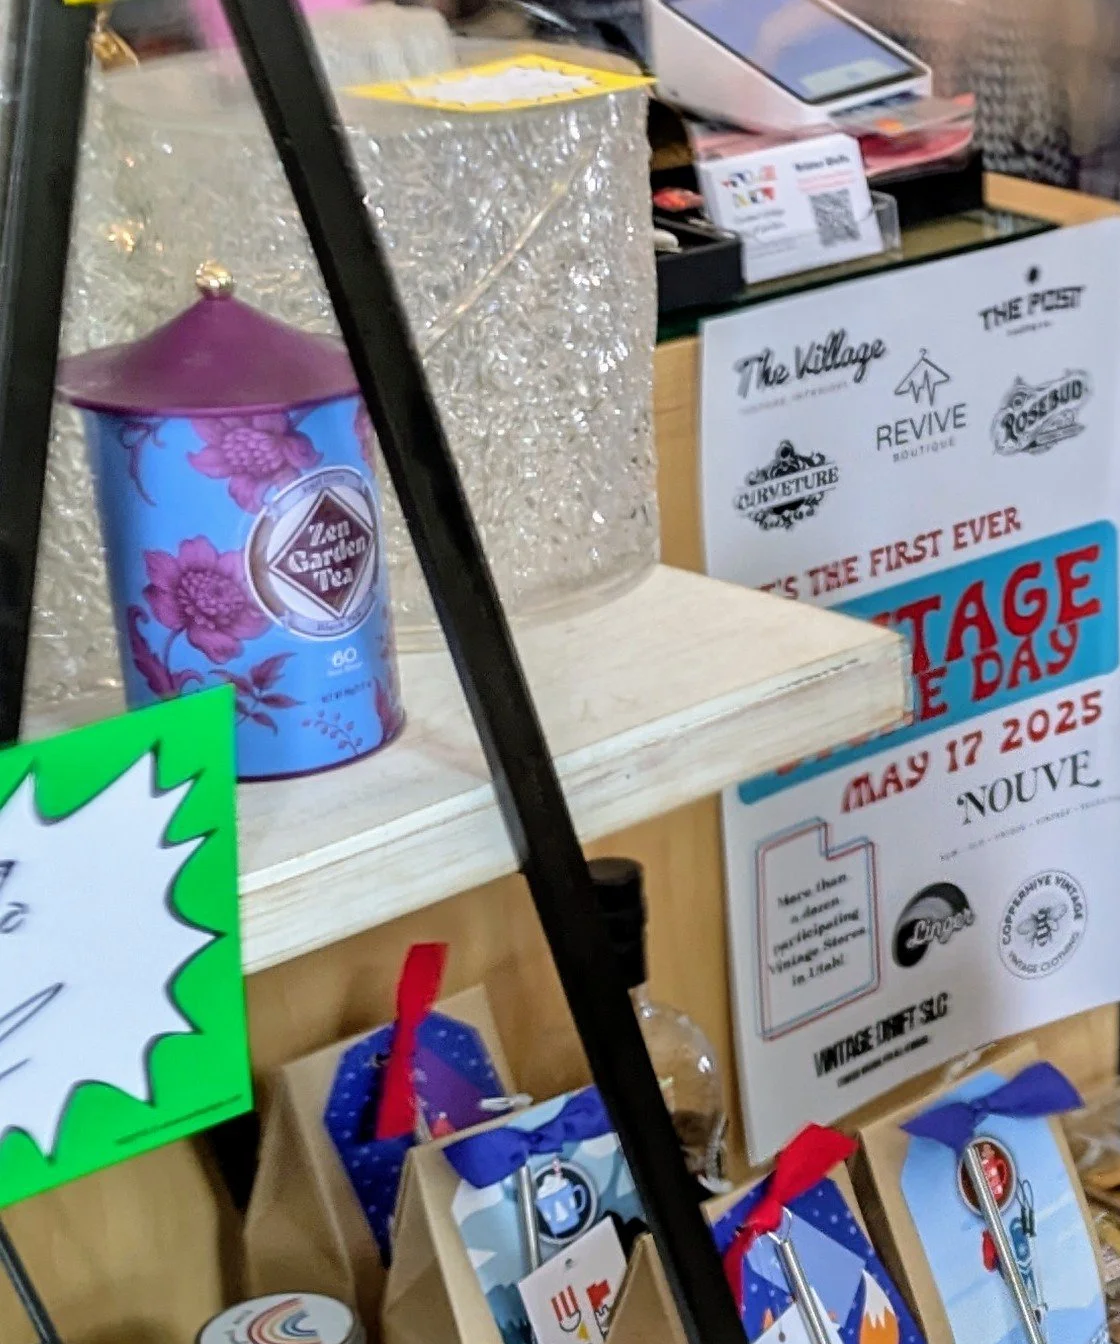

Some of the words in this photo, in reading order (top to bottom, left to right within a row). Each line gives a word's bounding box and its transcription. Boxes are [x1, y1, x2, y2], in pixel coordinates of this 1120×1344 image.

[978, 296, 1023, 331] THE
[1028, 285, 1086, 314] POST
[733, 347, 789, 399] The
[795, 328, 886, 383] Village
[876, 404, 967, 451] REVIVE
[893, 436, 956, 463] BOUTIQUE
[288, 536, 366, 574] Garden
[309, 520, 350, 547] Zen
[807, 556, 859, 596] THE
[870, 529, 943, 577] FIRST
[953, 507, 1022, 551] EVER
[313, 567, 354, 592] Tea
[868, 544, 1101, 675] TAGE
[971, 622, 1079, 702] DAY
[840, 751, 930, 813] MAY
[946, 730, 983, 773] 17
[1000, 690, 1103, 754] 2025
[957, 750, 1103, 825] NOUVE
[1002, 875, 1052, 946] COPPERHIVE
[1054, 875, 1084, 921] VINTAGE
[813, 1024, 874, 1078] VINTAGE
